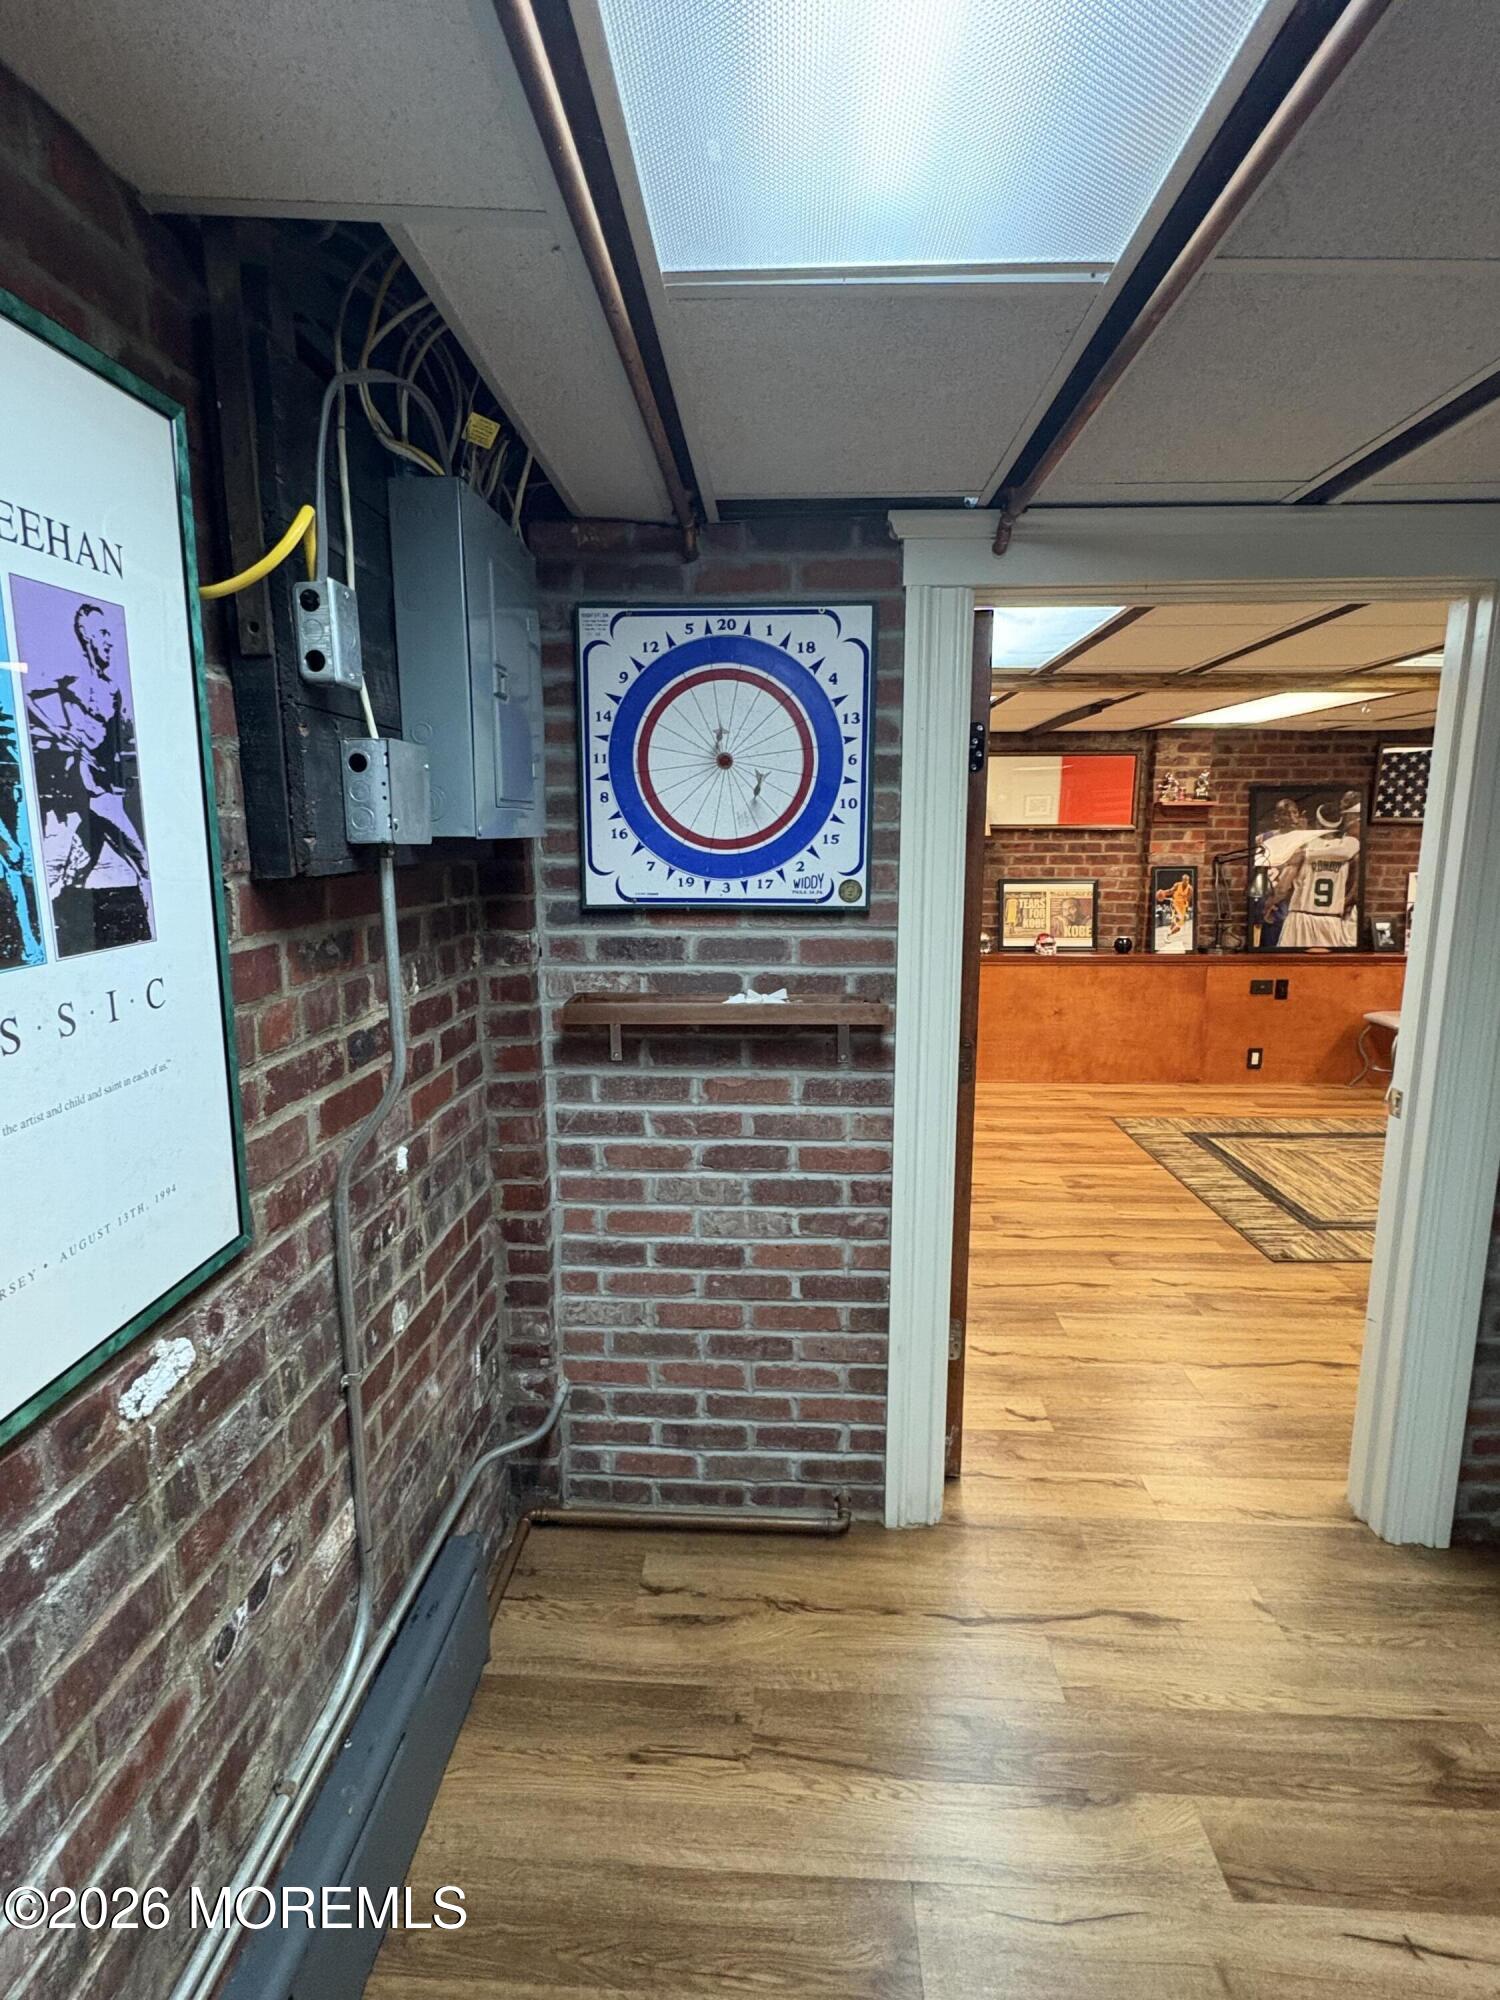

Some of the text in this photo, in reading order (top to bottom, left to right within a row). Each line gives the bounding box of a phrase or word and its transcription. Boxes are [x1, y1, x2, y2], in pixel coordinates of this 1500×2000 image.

[684, 623, 695, 635] 5
[717, 618, 737, 631] 20
[766, 623, 773, 636] 1
[642, 641, 660, 653] 12
[797, 641, 816, 654] 18
[618, 671, 629, 684] 9
[828, 672, 838, 685] 4
[595, 710, 612, 722] 14
[843, 712, 861, 725] 13
[593, 753, 607, 764] 11
[848, 754, 858, 765] 6
[600, 792, 609, 803] 8
[840, 798, 858, 809] 10
[611, 828, 628, 840] 16
[823, 834, 840, 845] 15
[646, 861, 656, 872] 7
[795, 861, 805, 872] 2
[677, 876, 695, 888] 19
[757, 879, 774, 889] 17
[793, 872, 825, 889] WIDDY
[721, 882, 731, 893] 3
[1314, 878, 1334, 907] 9
[1020, 899, 1046, 909] TEARS
[1029, 908, 1046, 918] FOR
[1023, 918, 1046, 929] KOBE
[1063, 925, 1092, 937] KOBE
[2, 1124, 18, 1137] the
[20, 1112, 44, 1129] artist
[46, 1103, 63, 1118] and
[64, 1093, 86, 1111] child
[87, 1087, 102, 1101] and
[103, 1080, 122, 1095] saint
[132, 1069, 149, 1083] each
[150, 1064, 158, 1076] of
[60, 1223, 112, 1263] AUGUST
[154, 1184, 177, 1203] 1994
